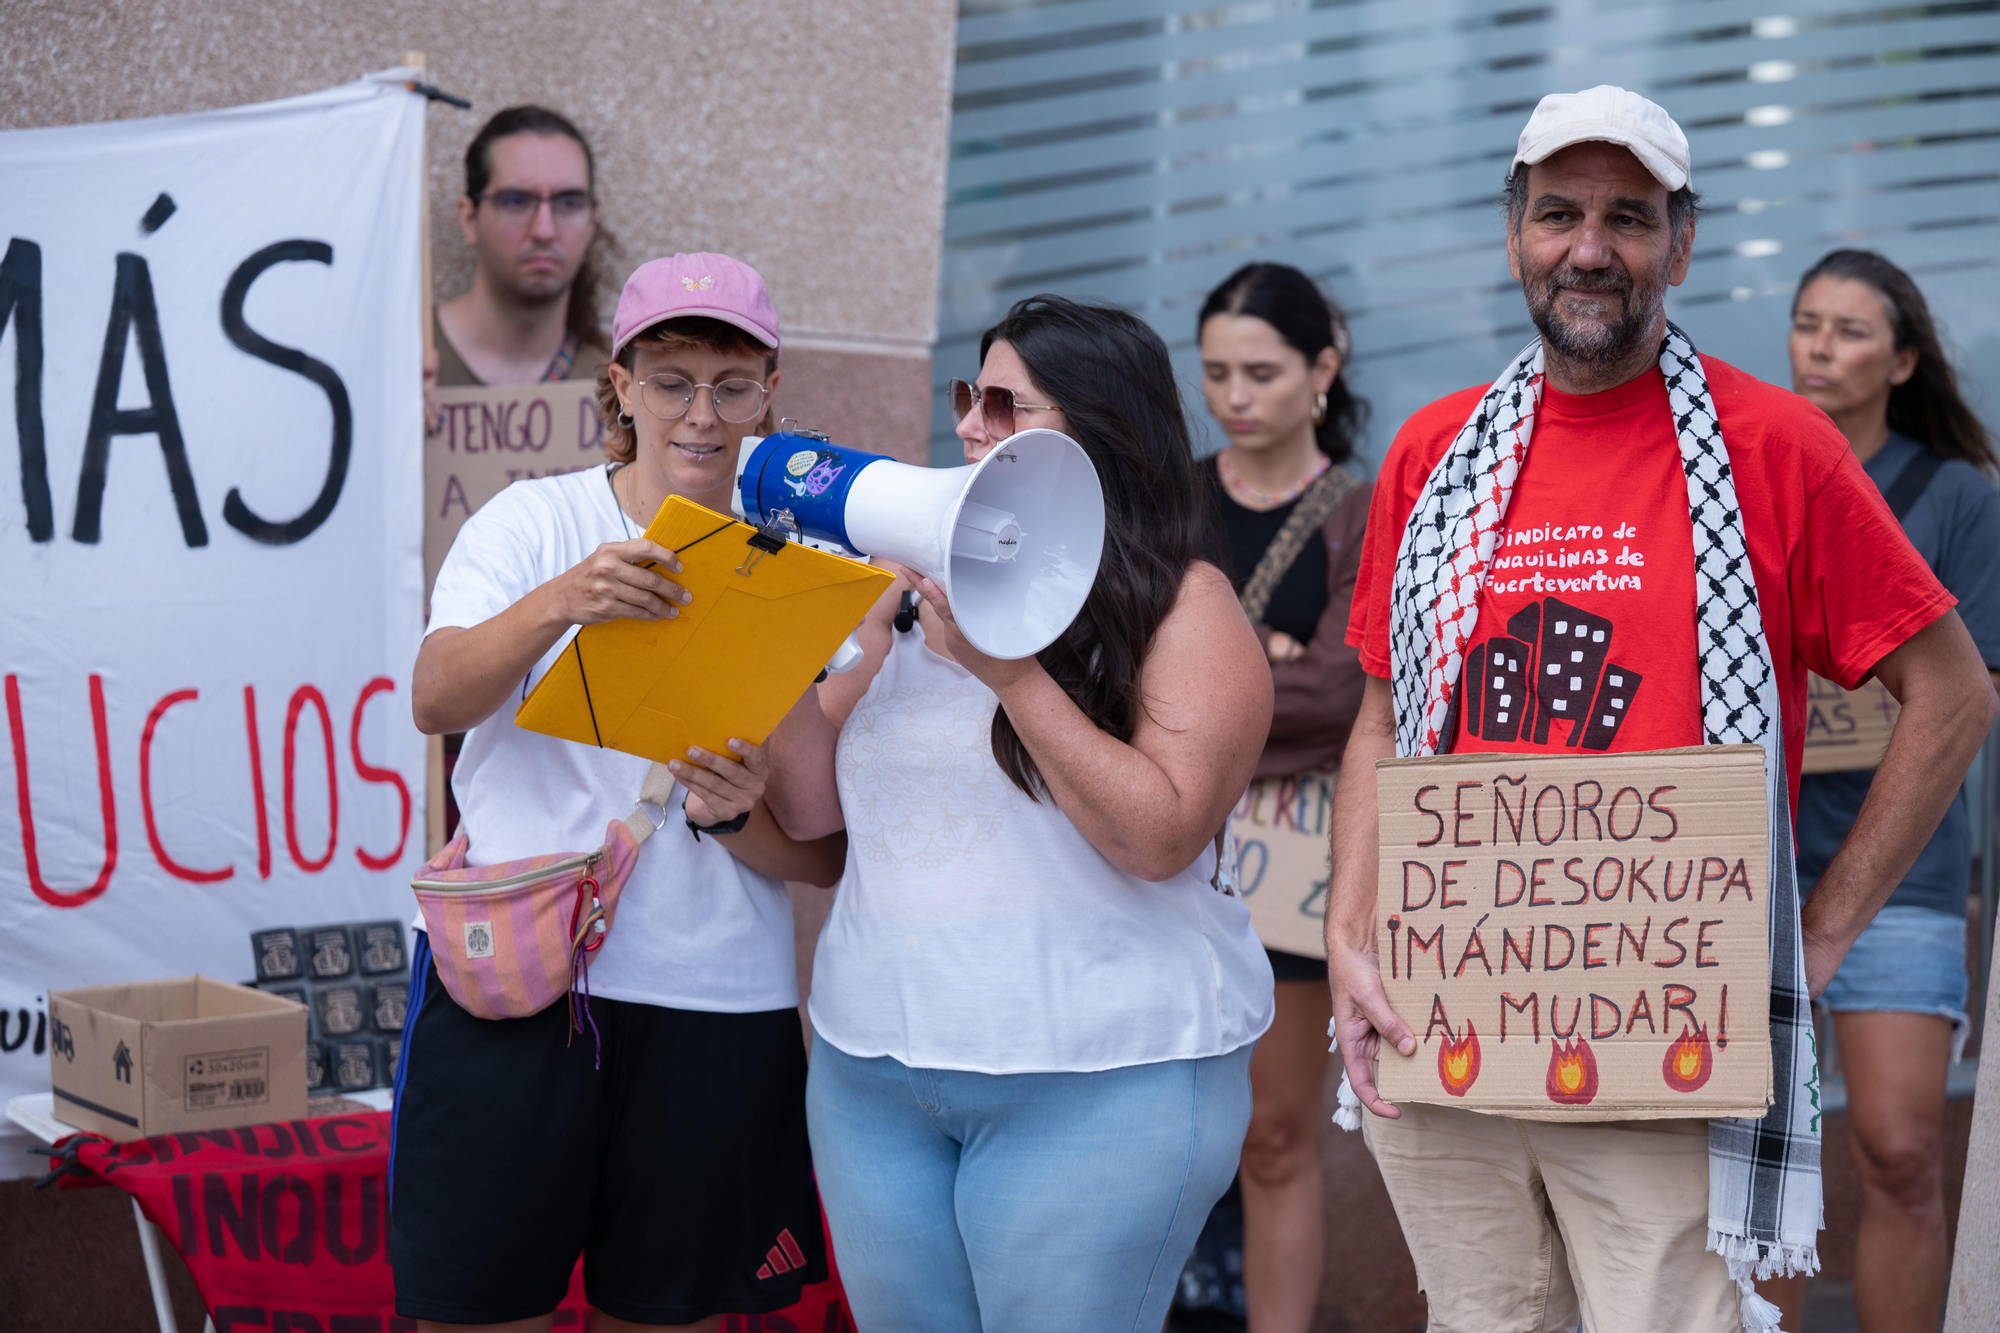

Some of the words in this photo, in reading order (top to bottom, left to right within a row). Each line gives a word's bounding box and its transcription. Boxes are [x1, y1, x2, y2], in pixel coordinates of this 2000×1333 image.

[441, 398, 552, 453] TENGO
[440, 475, 472, 517] A
[1613, 521, 1636, 539] de
[1615, 546, 1645, 566] de
[1413, 773, 1679, 848] SEÑOROS
[1402, 859, 1467, 912] DE
[1495, 856, 1753, 908] DESOKUPA
[1387, 914, 1723, 980] ¡MÁNDENSE
[1424, 993, 1455, 1044] A
